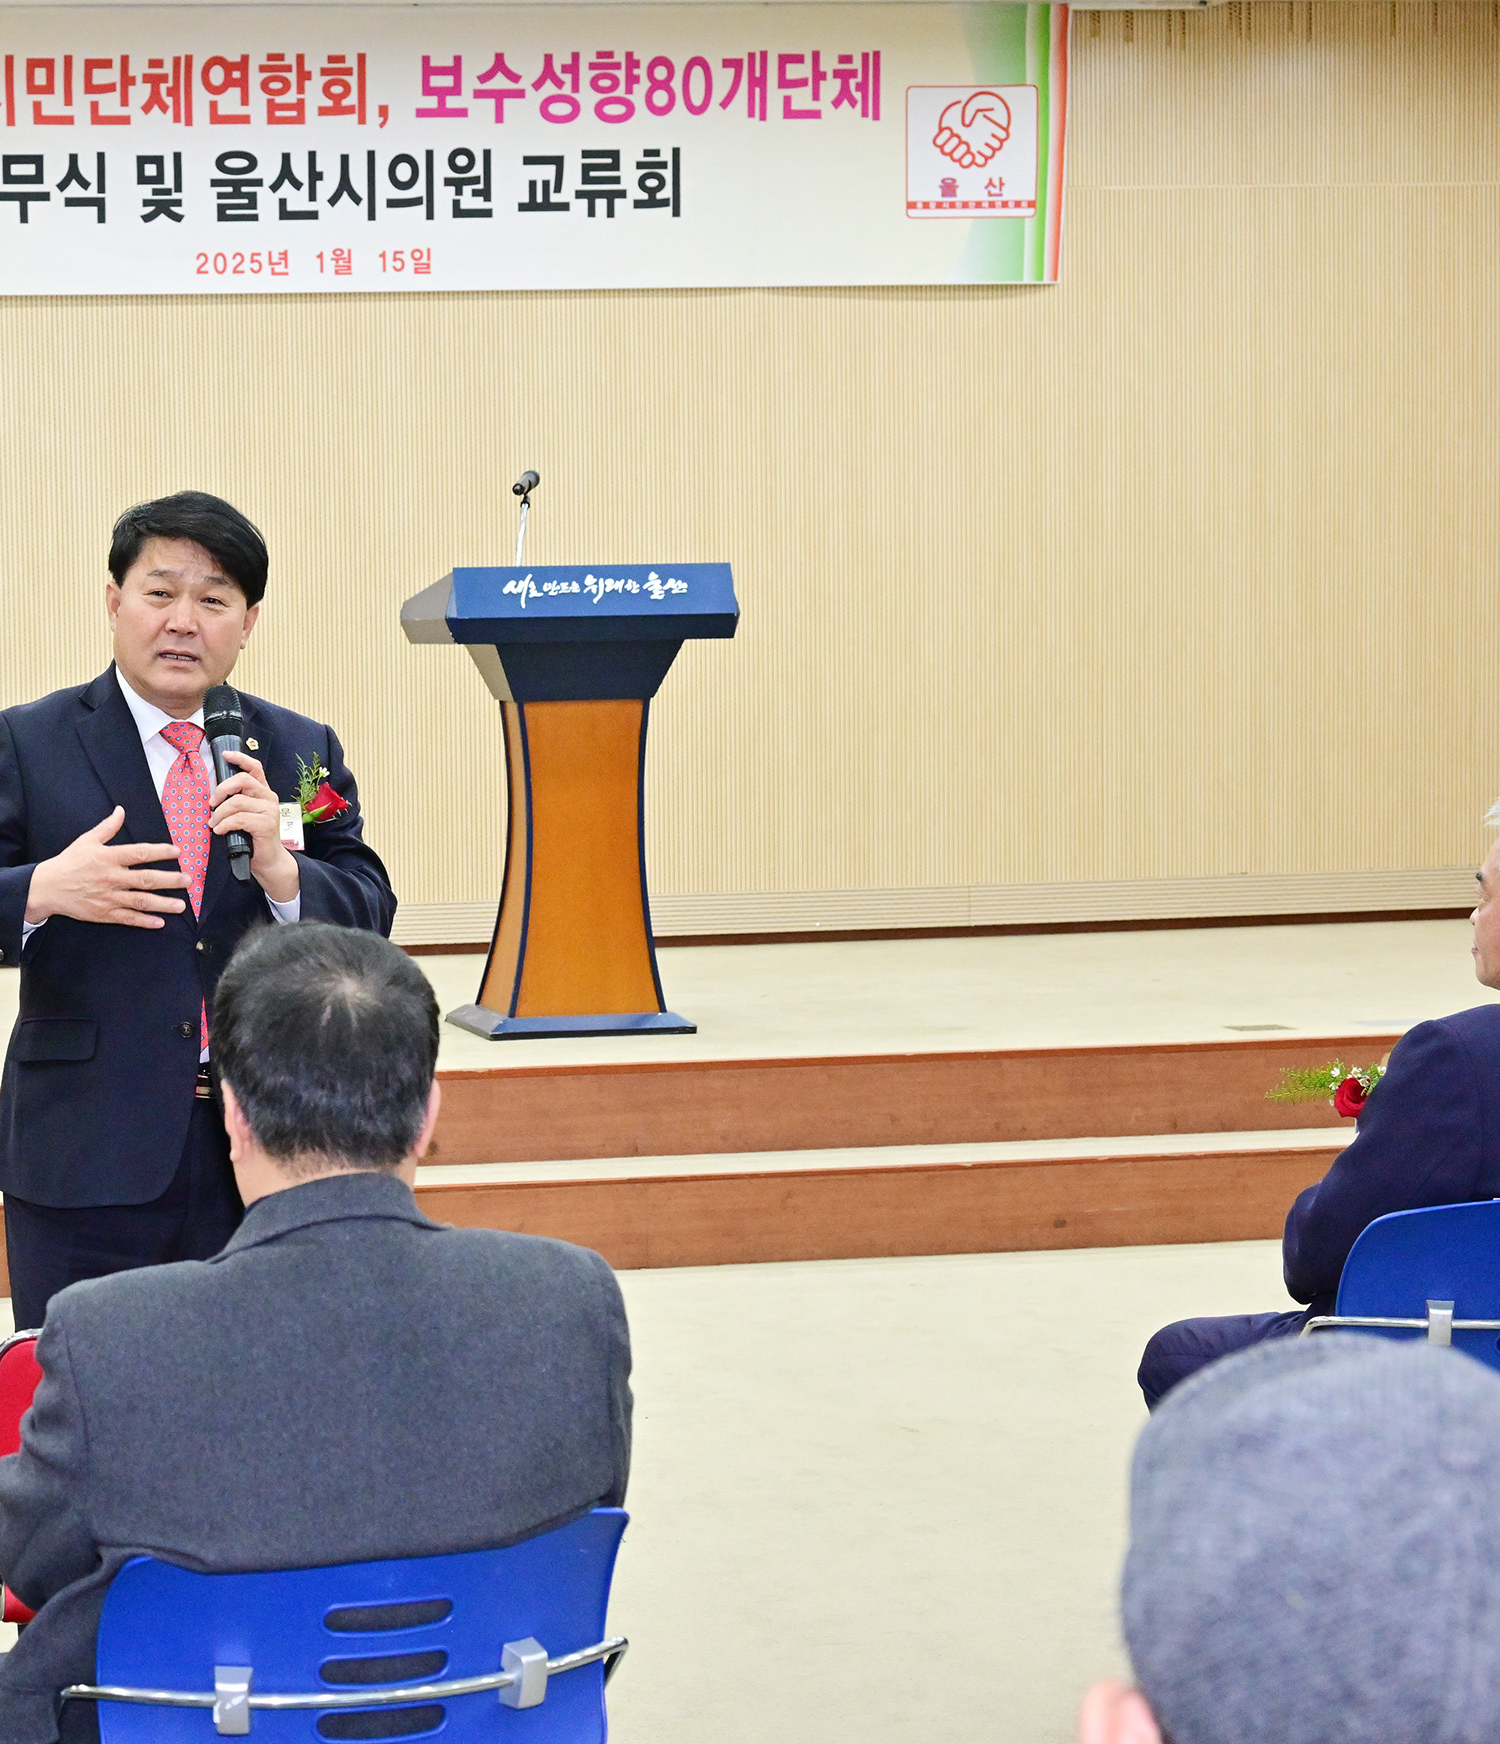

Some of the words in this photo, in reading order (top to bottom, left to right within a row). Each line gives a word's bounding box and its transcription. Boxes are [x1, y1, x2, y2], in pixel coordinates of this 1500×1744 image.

[415, 49, 882, 124] 보수성향80개단체
[136, 151, 185, 223] 및
[210, 147, 493, 222] 울산시의원
[517, 147, 682, 219] 교류회
[196, 250, 290, 276] 2025년
[315, 248, 353, 275] 1월
[378, 247, 432, 274] 15일
[502, 573, 544, 609] 새로
[543, 579, 581, 596] 만드는
[583, 573, 640, 605] 위대한
[643, 571, 689, 600] 울산
